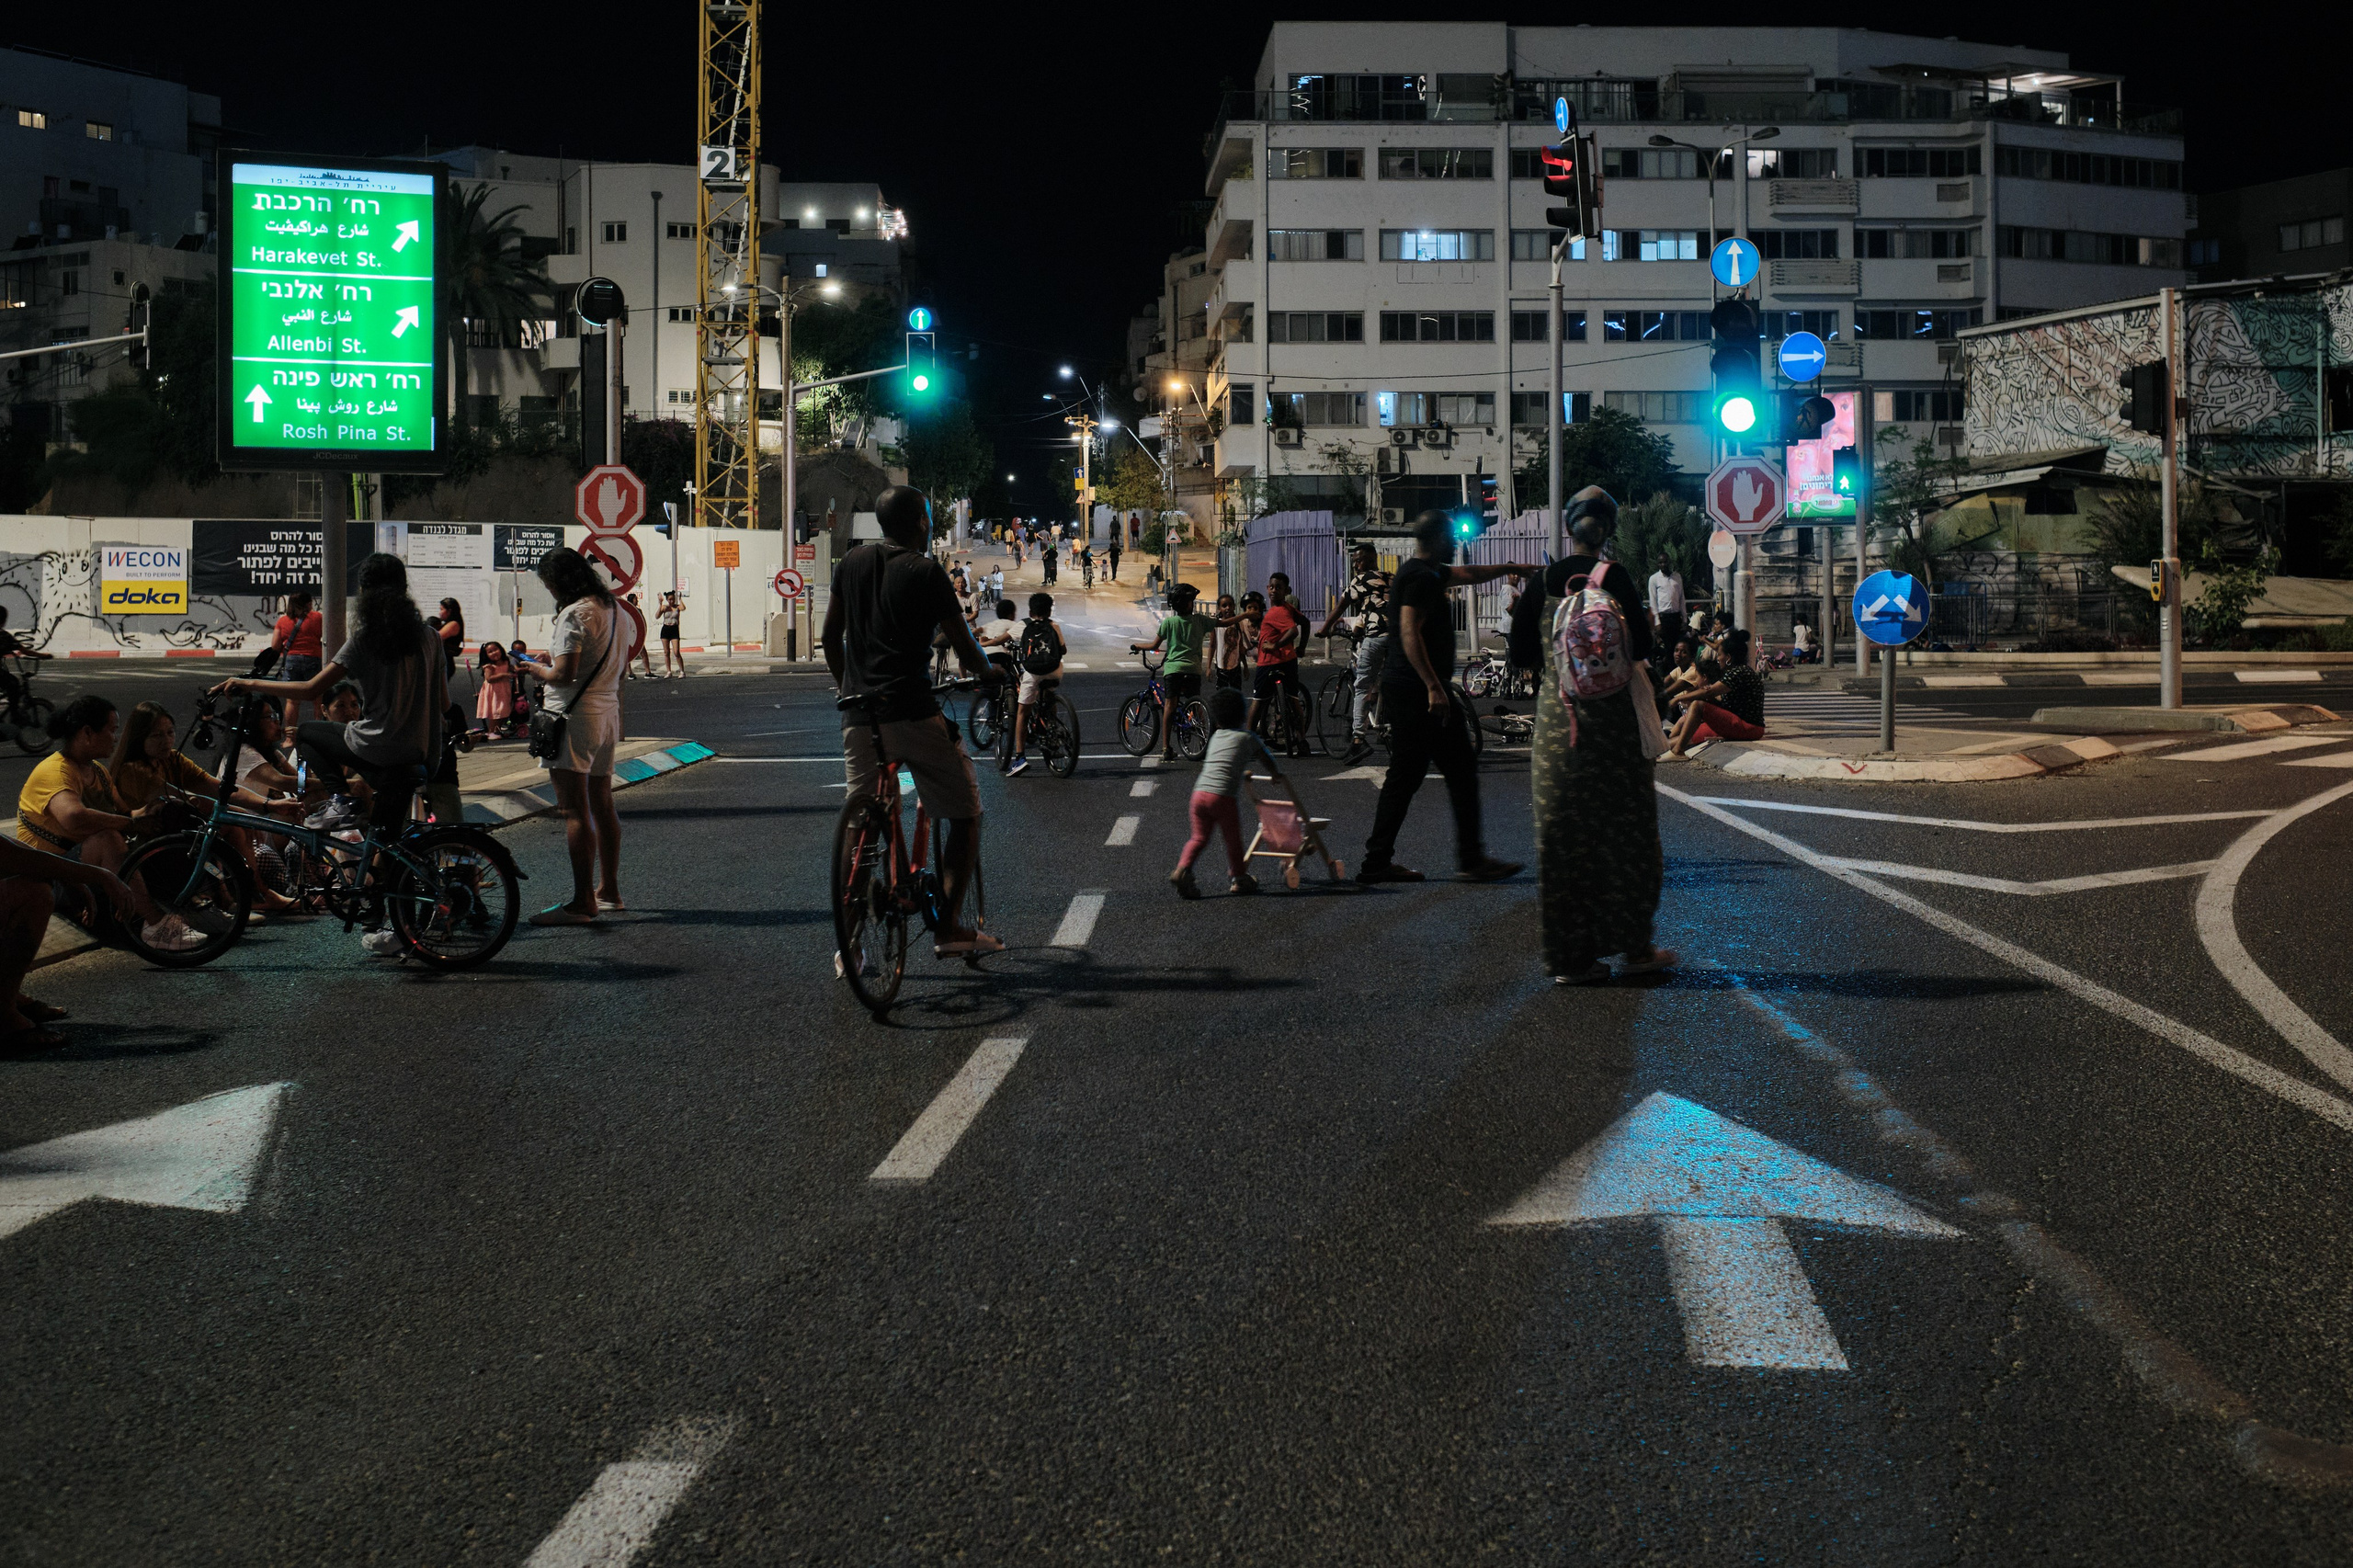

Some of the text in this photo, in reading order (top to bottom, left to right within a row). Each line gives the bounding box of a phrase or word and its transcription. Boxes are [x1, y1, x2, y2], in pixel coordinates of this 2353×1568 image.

[705, 150, 730, 178] 2
[357, 183, 396, 191] עיריית
[252, 193, 332, 212] הרכבת
[337, 223, 369, 238] شارع
[252, 245, 381, 267] Harakevet St.
[261, 279, 324, 300] אלנבי
[281, 309, 352, 326] شارع النبي
[267, 335, 367, 354] Allenbi St.
[273, 369, 320, 387] פינה
[330, 371, 377, 389] ראש
[328, 398, 359, 415] روش
[366, 400, 398, 415] شارع
[283, 423, 411, 441] Rosh Pina St.
[313, 451, 358, 460] JCDecaux
[270, 530, 323, 540] סור להרוס
[423, 524, 467, 535] מגדל לבנדה
[244, 544, 277, 553] שבנינו
[279, 544, 296, 553] מה
[299, 543, 313, 553] כל
[108, 551, 180, 567] WECON
[237, 555, 323, 569] ייבים לפתור
[251, 571, 323, 584] ת זה יחד!
[108, 587, 180, 604] doka
